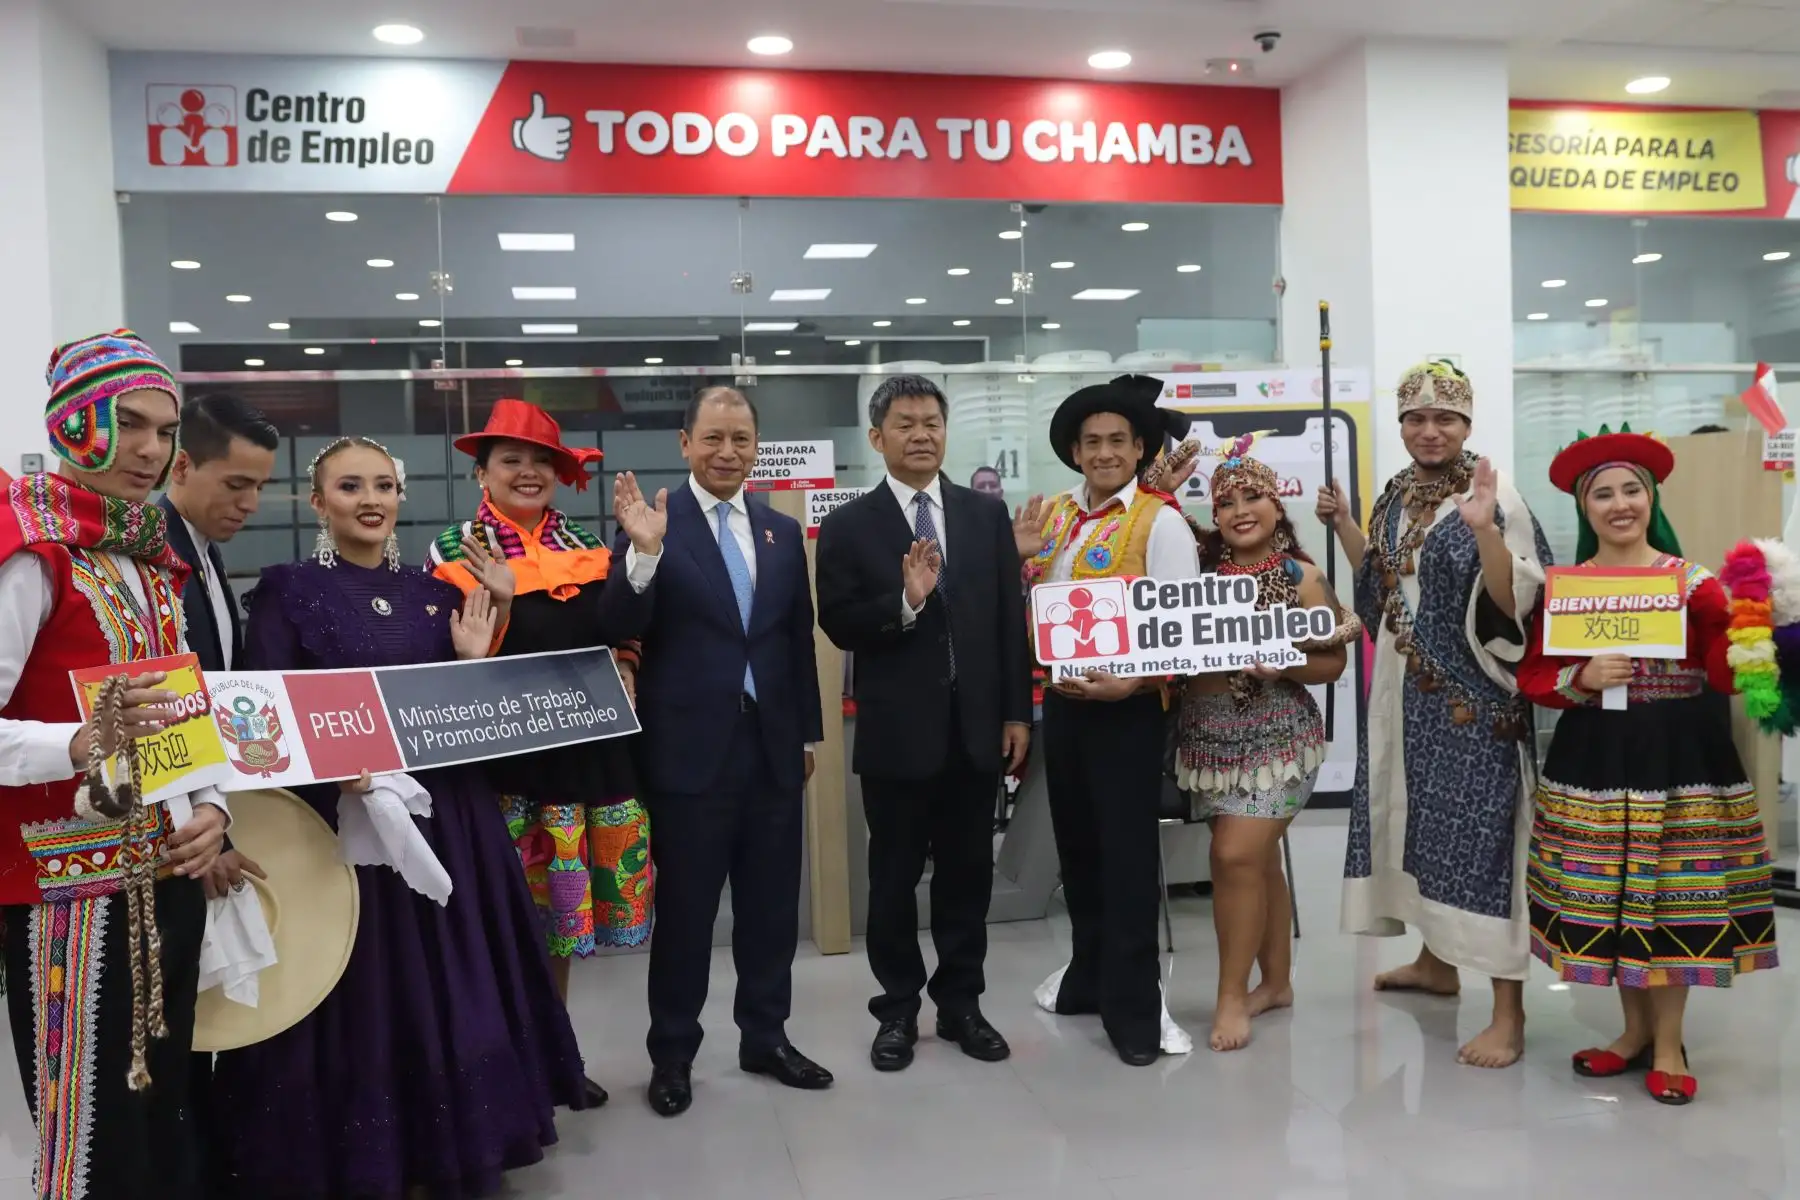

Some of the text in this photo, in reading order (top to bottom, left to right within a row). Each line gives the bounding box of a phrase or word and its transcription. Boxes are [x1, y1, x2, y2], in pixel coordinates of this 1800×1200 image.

[246, 87, 366, 125] Centro
[247, 129, 435, 169] de Empleo
[585, 109, 1253, 167] TODO PARA TU CHAMBA
[1614, 137, 1680, 158] PARA
[1685, 139, 1716, 160] LA
[1509, 165, 1740, 193] QUEDA DE EMPLEO
[757, 445, 816, 456] ORÍA PARA
[995, 449, 1020, 479] 41
[812, 504, 827, 513] LA
[1132, 576, 1255, 612] Centro
[1548, 593, 1680, 613] BIENVENIDOS
[1137, 608, 1332, 650] de Empleo
[1583, 615, 1641, 642] 欢迎
[1142, 656, 1198, 673] meta,
[1203, 654, 1222, 668] tu
[1227, 648, 1303, 666] trabajo.
[240, 679, 254, 690] DEL
[309, 701, 377, 739] PERÚ
[398, 687, 588, 729] Ministerio de Trabajo
[407, 705, 619, 756] y Promoción del Empleo
[137, 731, 193, 777] 欢迎
